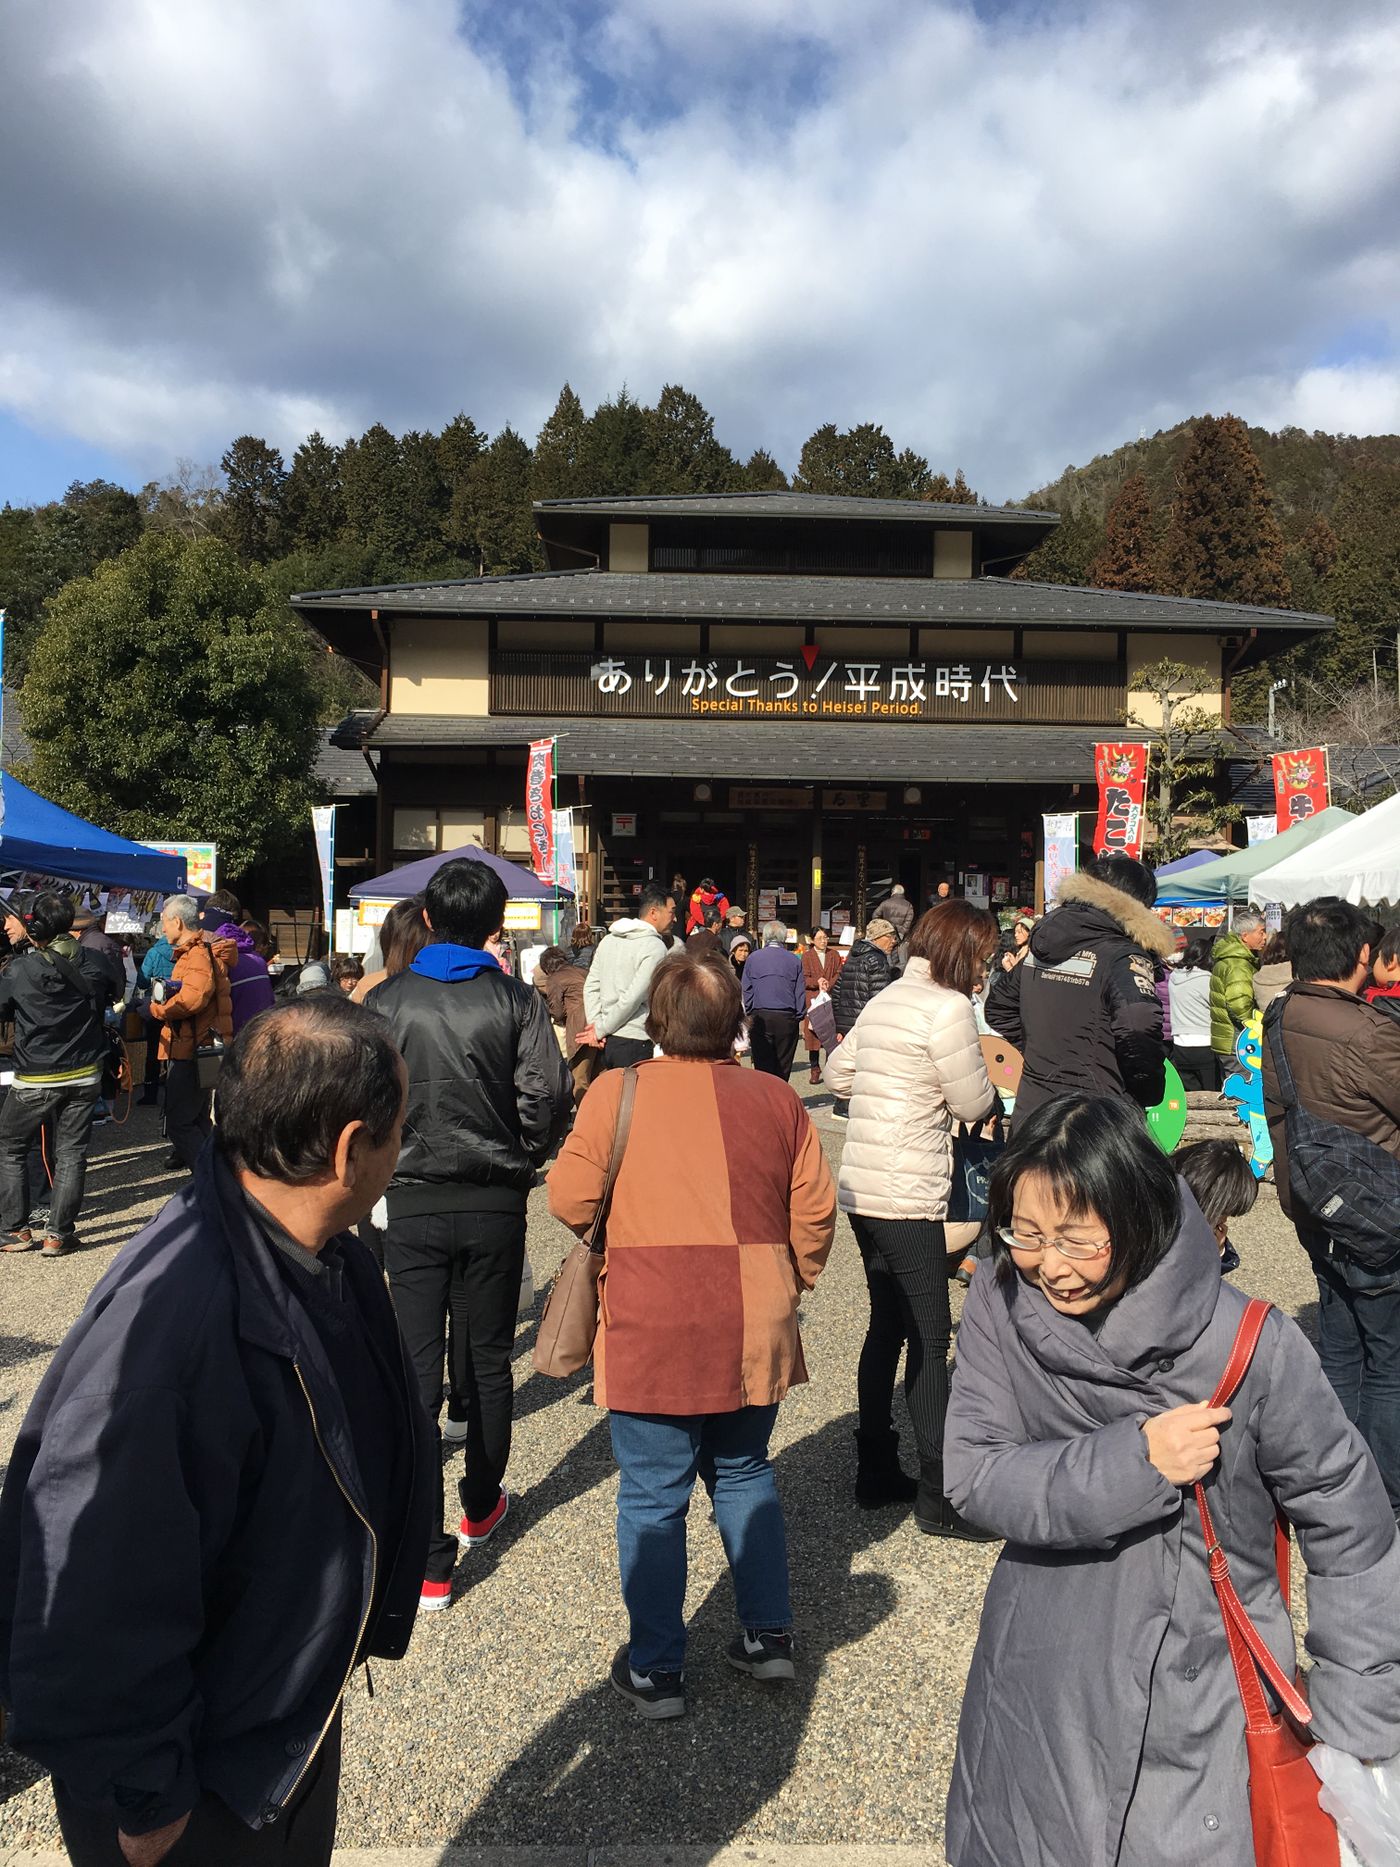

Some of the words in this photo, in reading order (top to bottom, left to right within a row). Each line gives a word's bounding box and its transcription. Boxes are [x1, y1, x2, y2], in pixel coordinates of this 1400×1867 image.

[692, 699, 743, 714] Special
[748, 700, 798, 713] Thanks
[803, 701, 817, 713] to
[823, 701, 867, 714] Heisei
[872, 701, 922, 715] Period.
